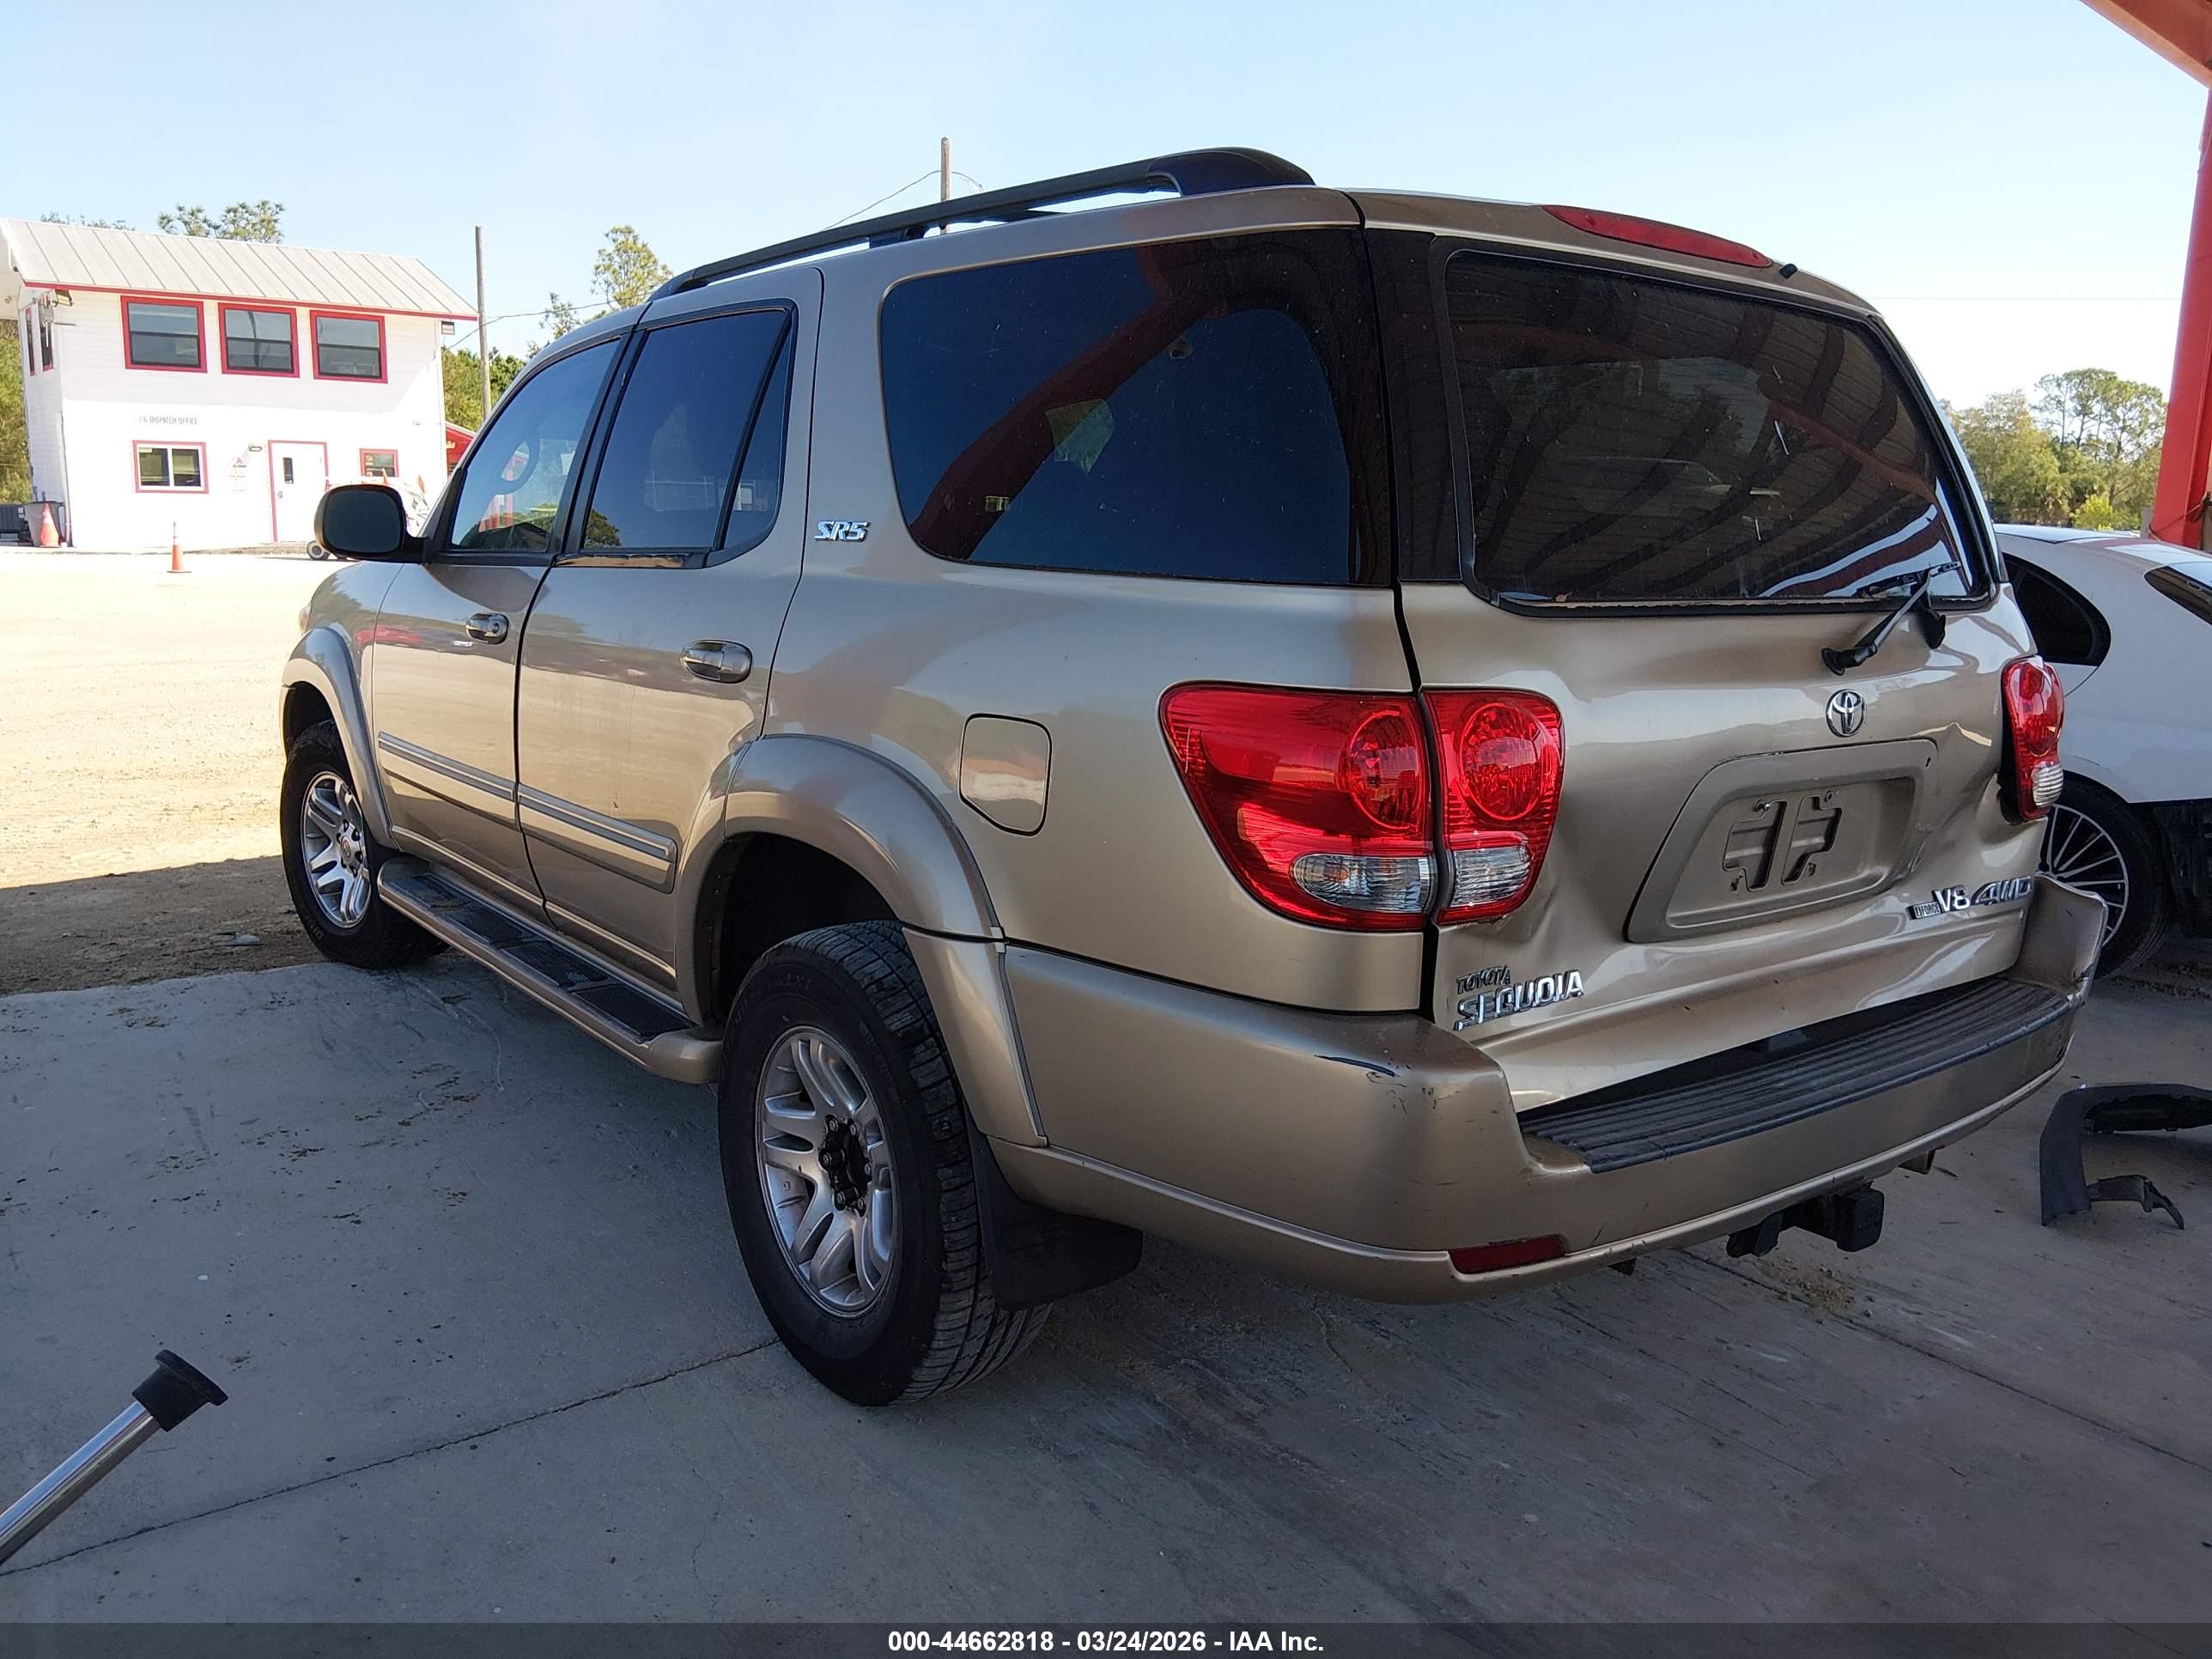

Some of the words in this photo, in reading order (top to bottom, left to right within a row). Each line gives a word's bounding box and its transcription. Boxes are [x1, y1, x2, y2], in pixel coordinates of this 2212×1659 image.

[814, 520, 871, 543] SR5
[1933, 884, 1971, 913] V8
[1972, 876, 2033, 906] 4WD
[1455, 964, 1512, 994] TOYOTA
[1453, 969, 1584, 1030] SEQUOIA
